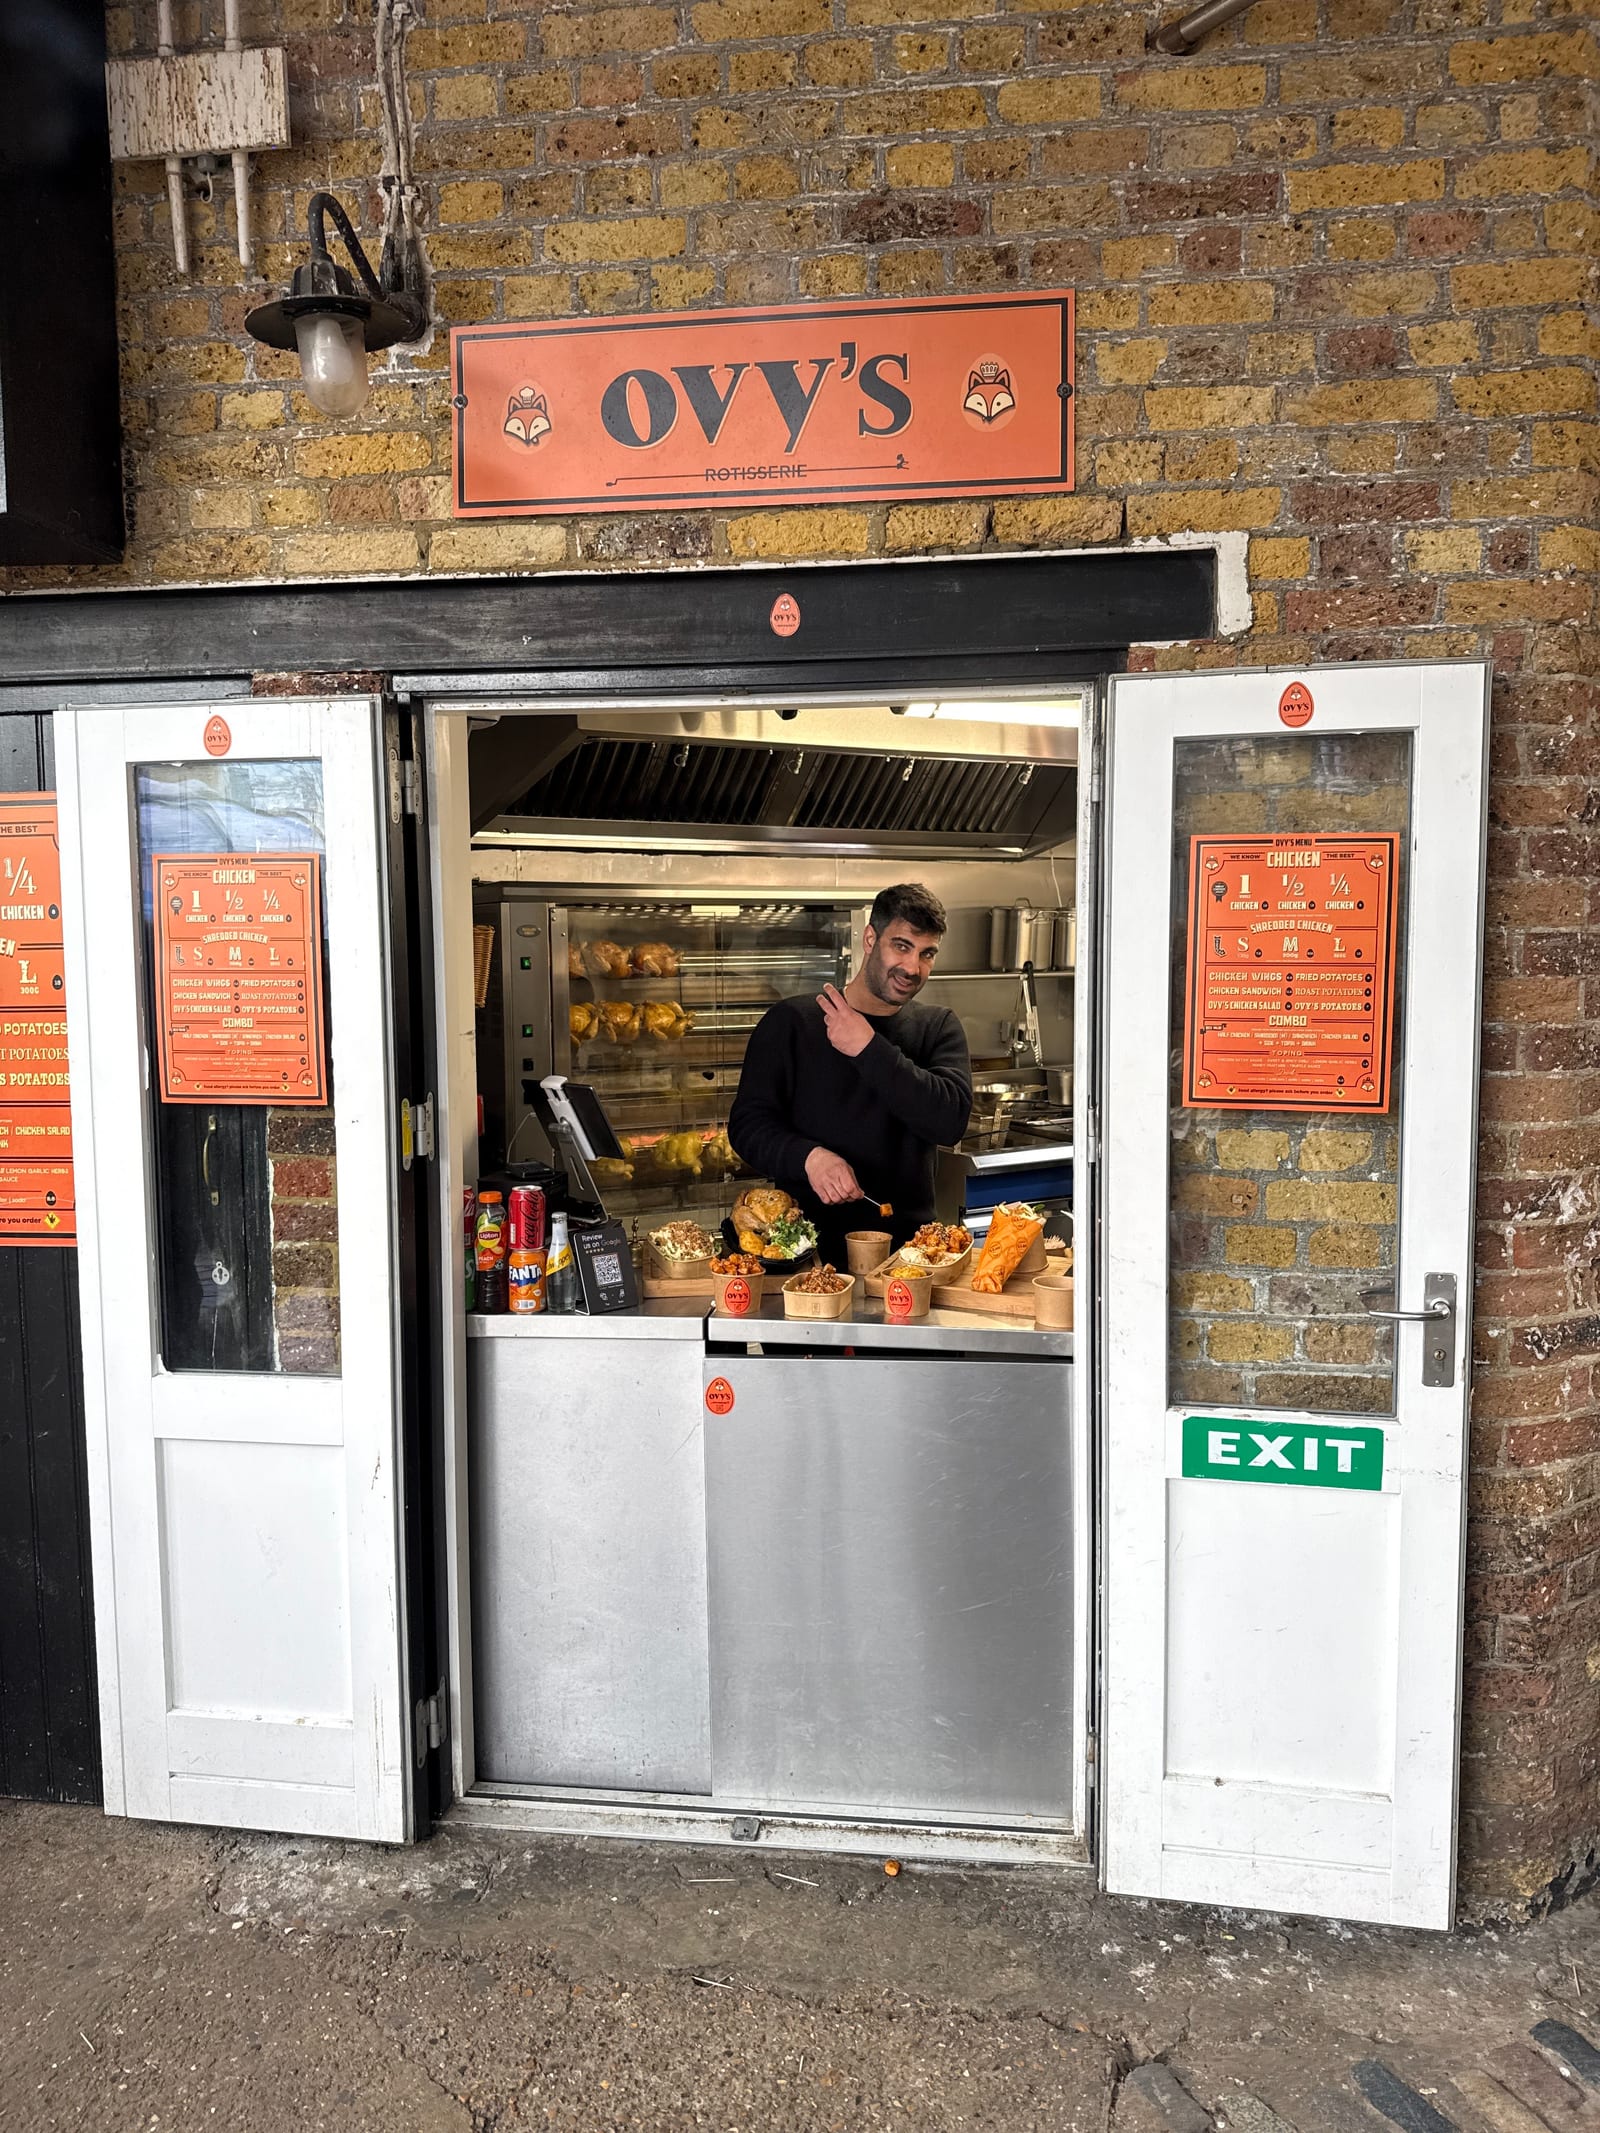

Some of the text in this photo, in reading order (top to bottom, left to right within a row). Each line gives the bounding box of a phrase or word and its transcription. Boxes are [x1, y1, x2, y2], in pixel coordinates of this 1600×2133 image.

[601, 341, 914, 455] OVY'S
[705, 464, 808, 482] ROTISSERIE
[1283, 702, 1309, 712] OVY'S
[15, 825, 38, 833] BEST
[1295, 838, 1312, 846] MENU
[1266, 851, 1321, 868] CHICKEN
[212, 869, 256, 885] CHICKEN
[1230, 901, 1259, 910] CHICKEN
[1278, 901, 1307, 910] CHICKEN
[1325, 901, 1355, 910] CHICKEN
[1, 904, 45, 920] CHICKEN
[1250, 919, 1334, 935] SHREDDED CHICKEN
[202, 931, 269, 945] SHREDDED CHICKEN
[1282, 936, 1299, 952] M
[1237, 937, 1249, 952] S
[1333, 937, 1347, 952] L
[193, 946, 203, 961] S
[229, 946, 242, 961] M
[269, 947, 280, 961] L
[18, 960, 37, 984] L
[1209, 972, 1282, 981] CHICKEN WINGS
[1295, 973, 1363, 982] FRIED POTATOES
[261, 979, 296, 988] POTATOES
[1208, 986, 1282, 995] CHICKEN SANDWICH
[1322, 988, 1363, 997] POTATOES
[1208, 1001, 1281, 1010] OVY'S CHICKEN SALAD
[1294, 1002, 1362, 1011] OVY'S POTATOES
[222, 1018, 253, 1028] COMBO
[1268, 1015, 1307, 1027] COMBO
[4, 1022, 68, 1036] POTATOES
[9, 1047, 71, 1060] POTATOES
[9, 1072, 71, 1086] POTATOES
[15, 1126, 46, 1136] CHICKEN
[47, 1126, 71, 1136] SALAD
[22, 1216, 41, 1224] order
[480, 1232, 498, 1240] Lipton
[581, 1233, 602, 1242] Review
[1207, 1430, 1366, 1473] EXIT
